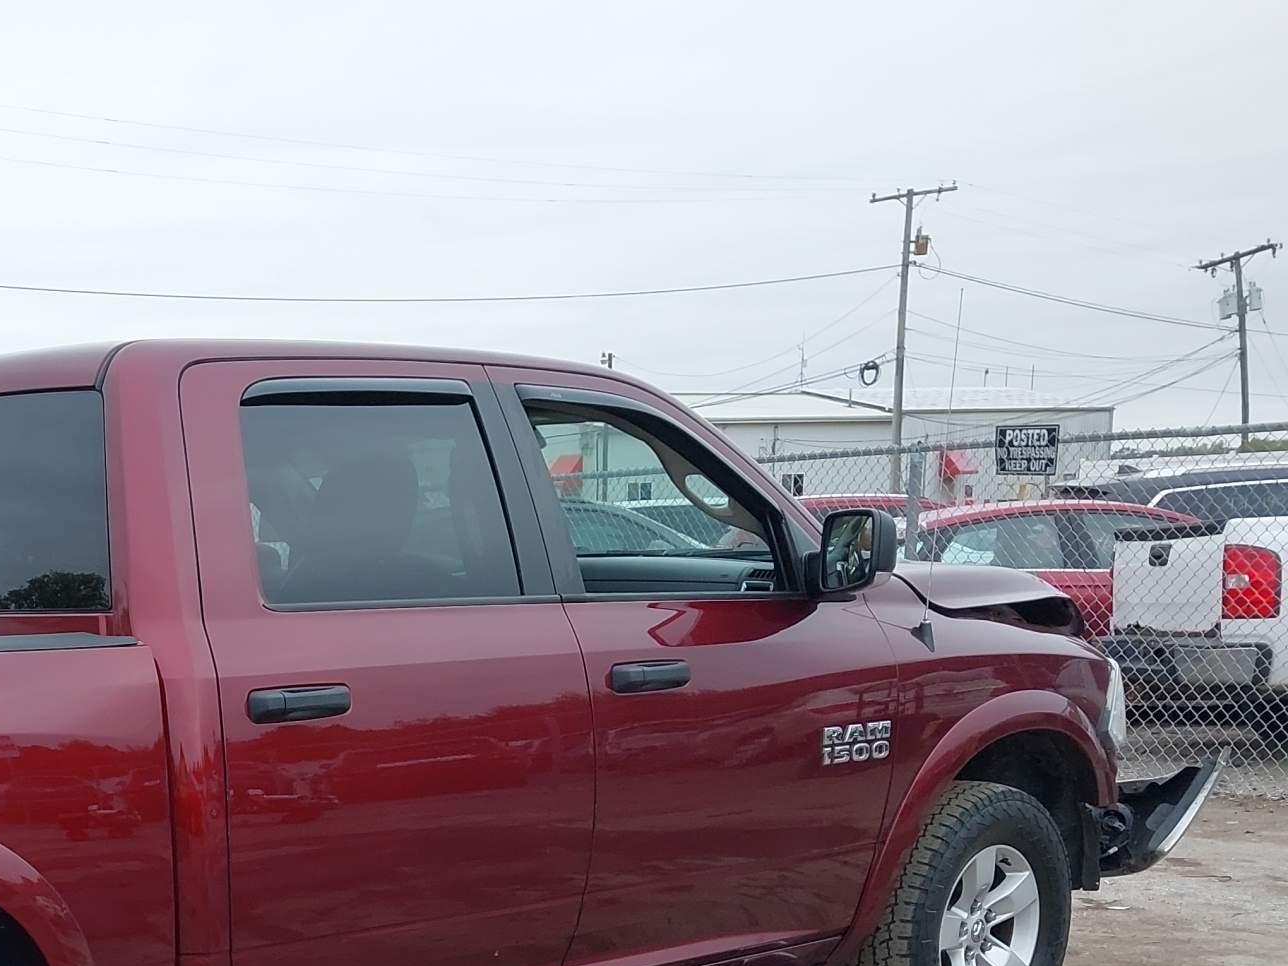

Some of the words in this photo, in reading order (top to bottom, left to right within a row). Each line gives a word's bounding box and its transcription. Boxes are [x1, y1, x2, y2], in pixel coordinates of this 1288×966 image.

[1005, 429, 1048, 446] POSTED
[997, 447, 1008, 458] NO
[1009, 447, 1055, 459] TRESPASSING
[1005, 460, 1027, 471] KEEP
[1030, 459, 1047, 471] OUT
[822, 720, 891, 745] RAM
[822, 741, 890, 765] 1500
